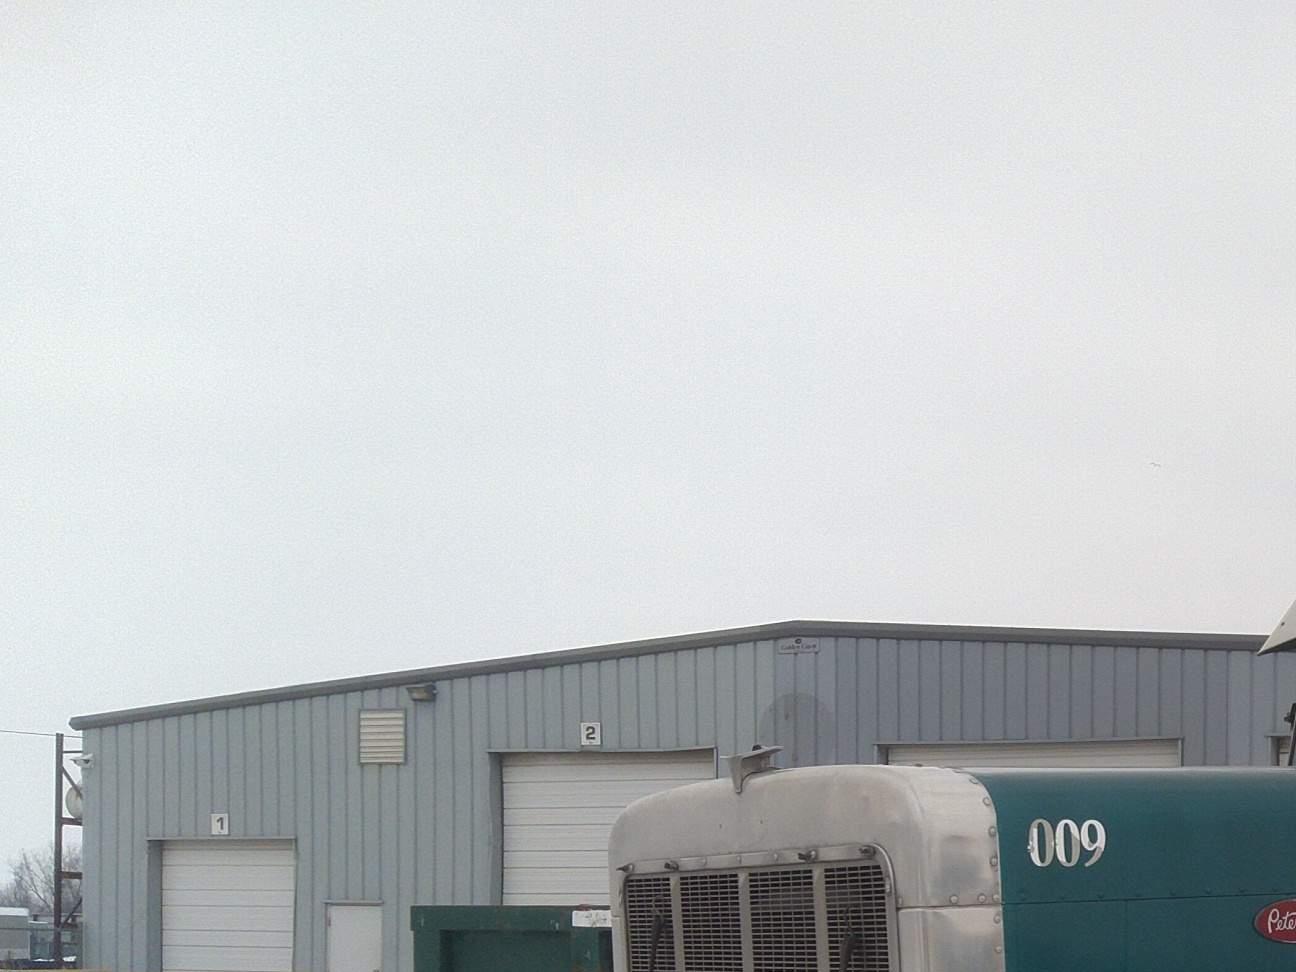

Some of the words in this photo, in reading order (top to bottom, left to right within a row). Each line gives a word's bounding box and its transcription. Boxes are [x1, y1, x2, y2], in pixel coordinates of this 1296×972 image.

[585, 725, 596, 740] 2
[216, 816, 224, 831] 1
[1027, 818, 1106, 867] 009
